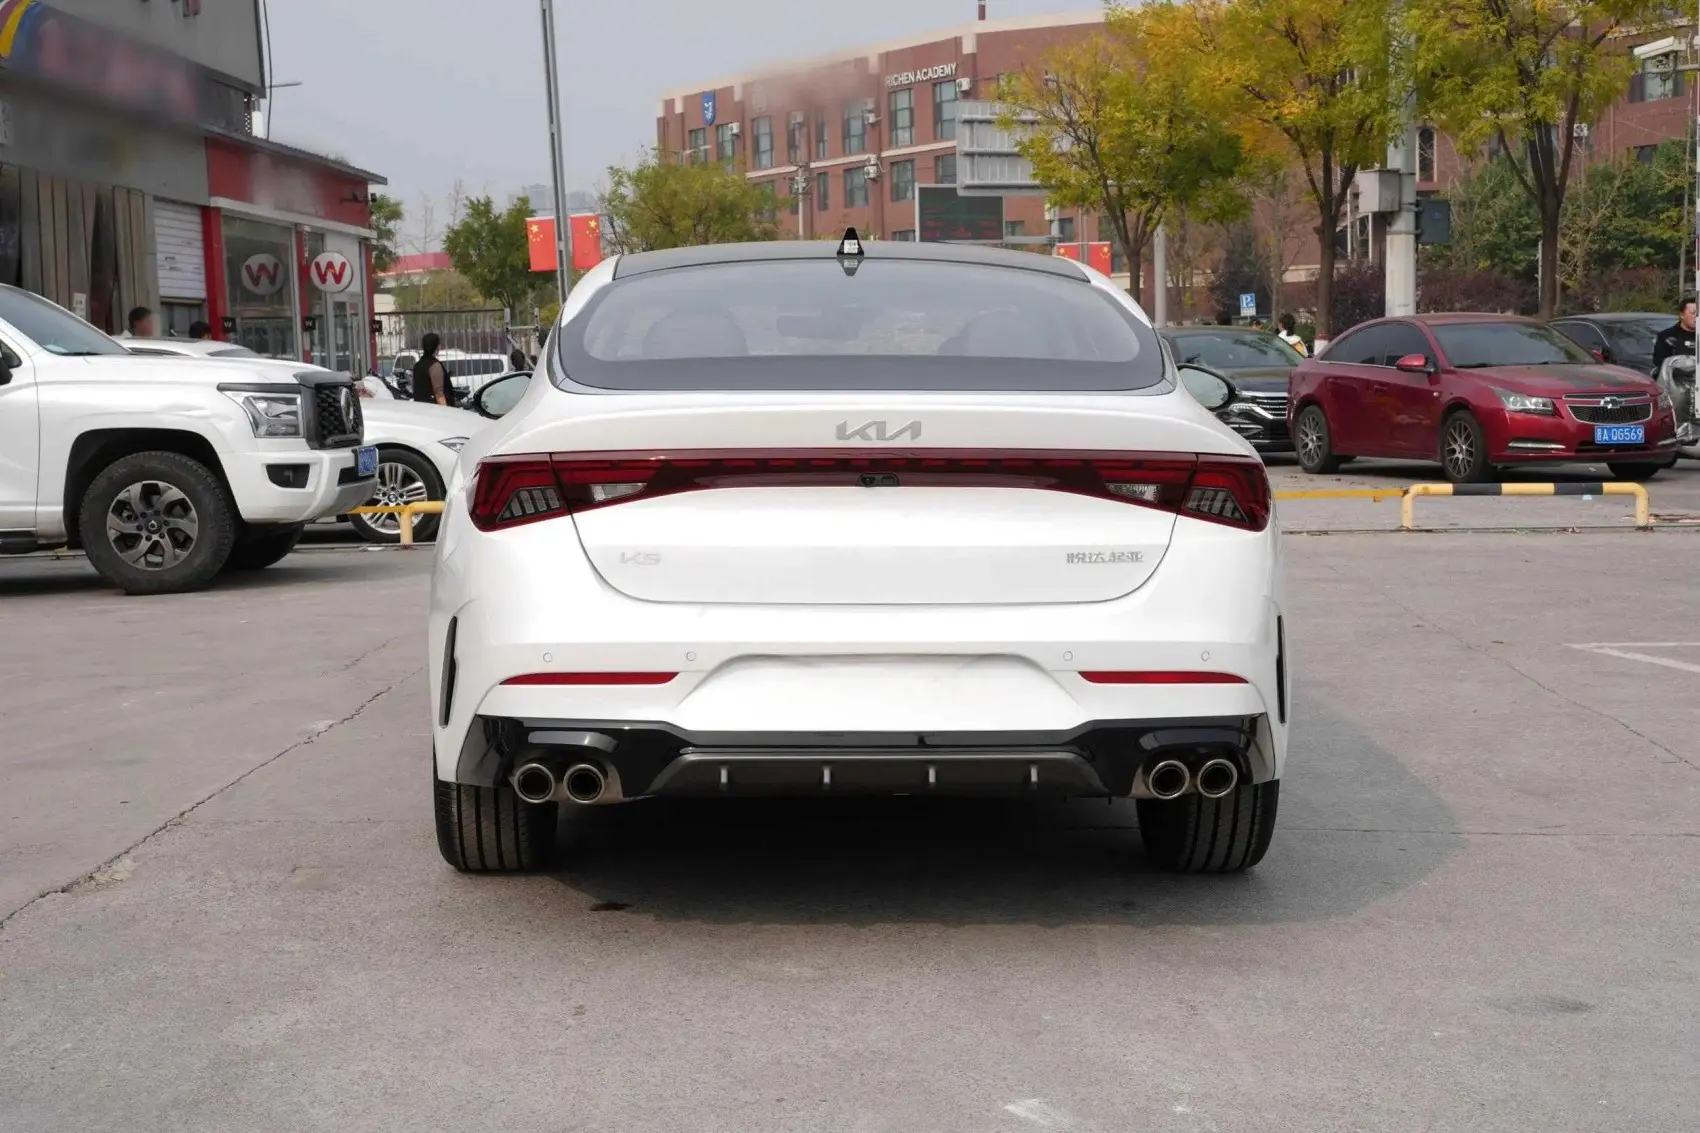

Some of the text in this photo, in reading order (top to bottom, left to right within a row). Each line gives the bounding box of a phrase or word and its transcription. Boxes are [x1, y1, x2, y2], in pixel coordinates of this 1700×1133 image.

[916, 62, 957, 82] ACADEMY
[314, 260, 347, 285] W
[1242, 295, 1252, 308] P
[835, 420, 922, 441] KIA
[1611, 428, 1643, 441] QG569
[619, 551, 662, 566] K5
